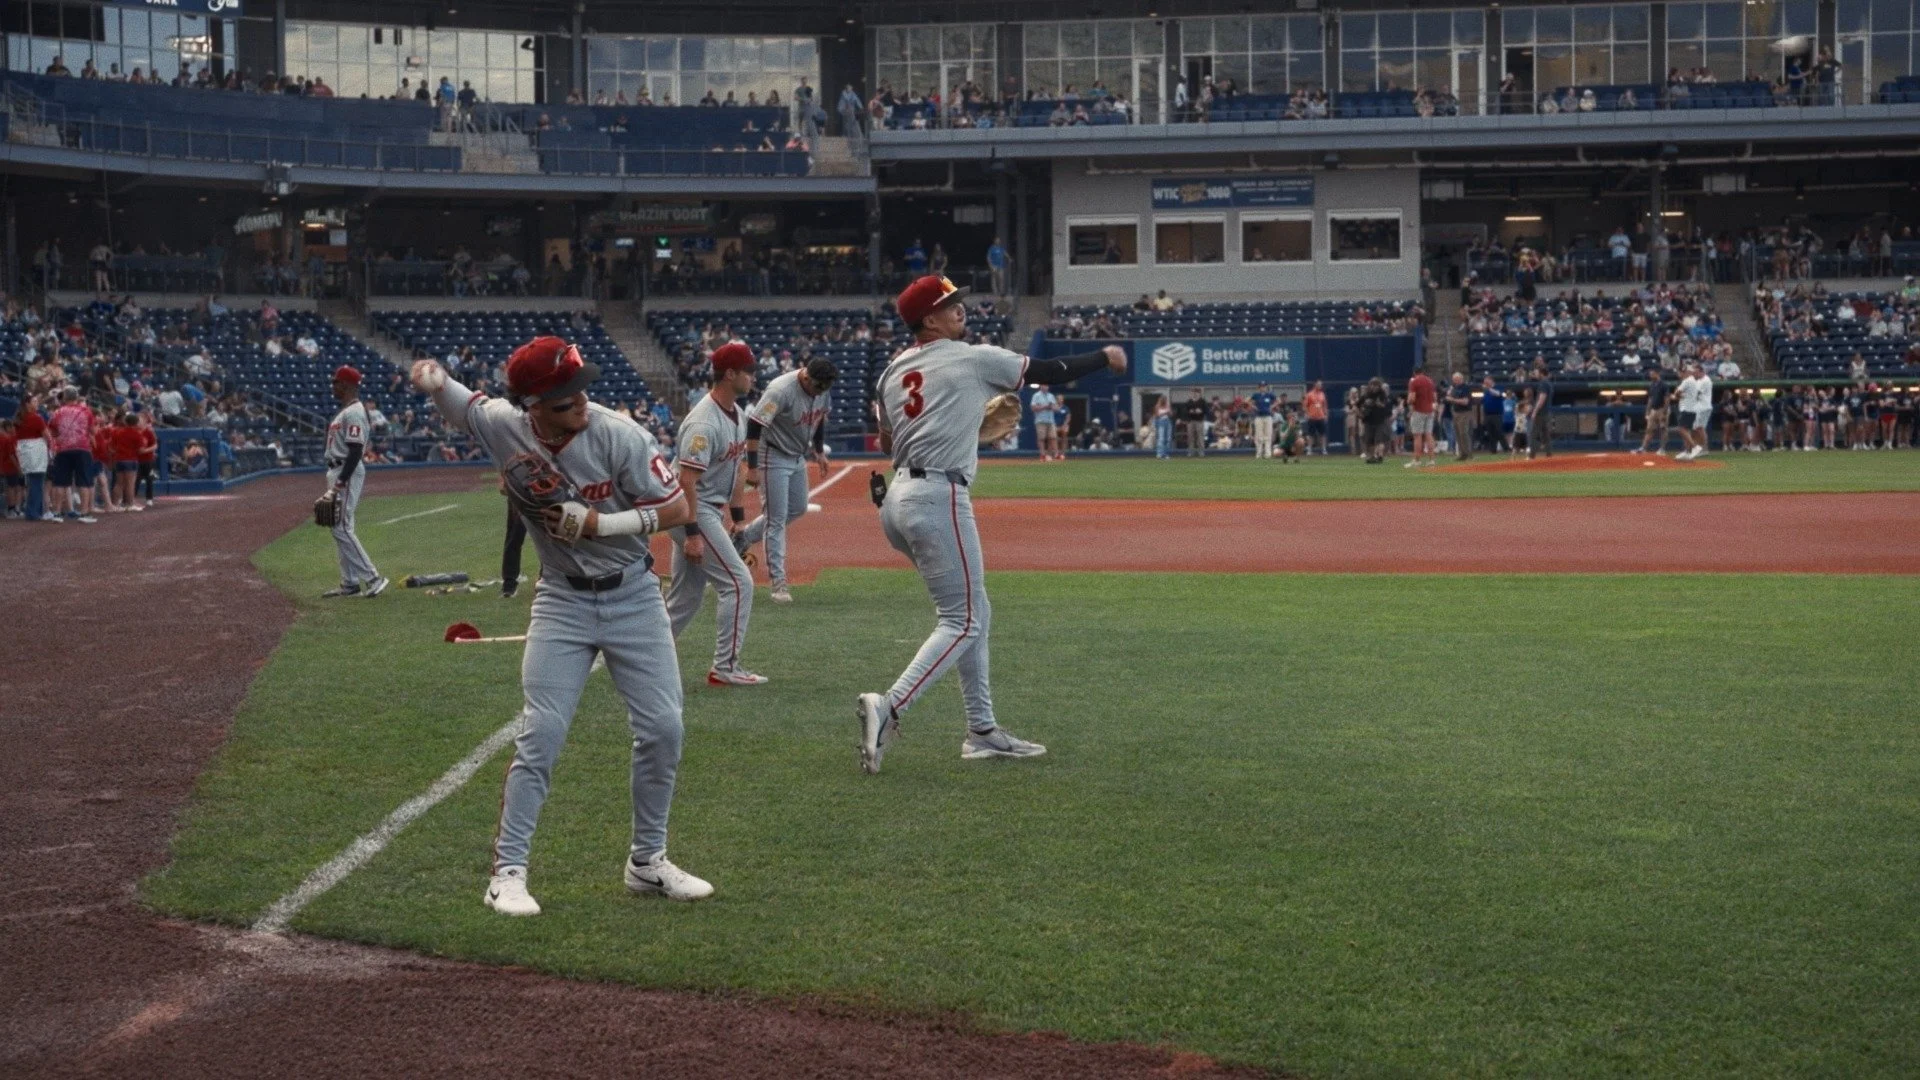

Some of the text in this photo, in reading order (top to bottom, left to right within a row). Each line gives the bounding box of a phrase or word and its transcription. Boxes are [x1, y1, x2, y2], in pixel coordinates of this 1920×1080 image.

[1153, 187, 1179, 200] WTIC
[1202, 348, 1290, 361] Better Built
[1202, 361, 1290, 373] Basements
[901, 370, 925, 420] 3
